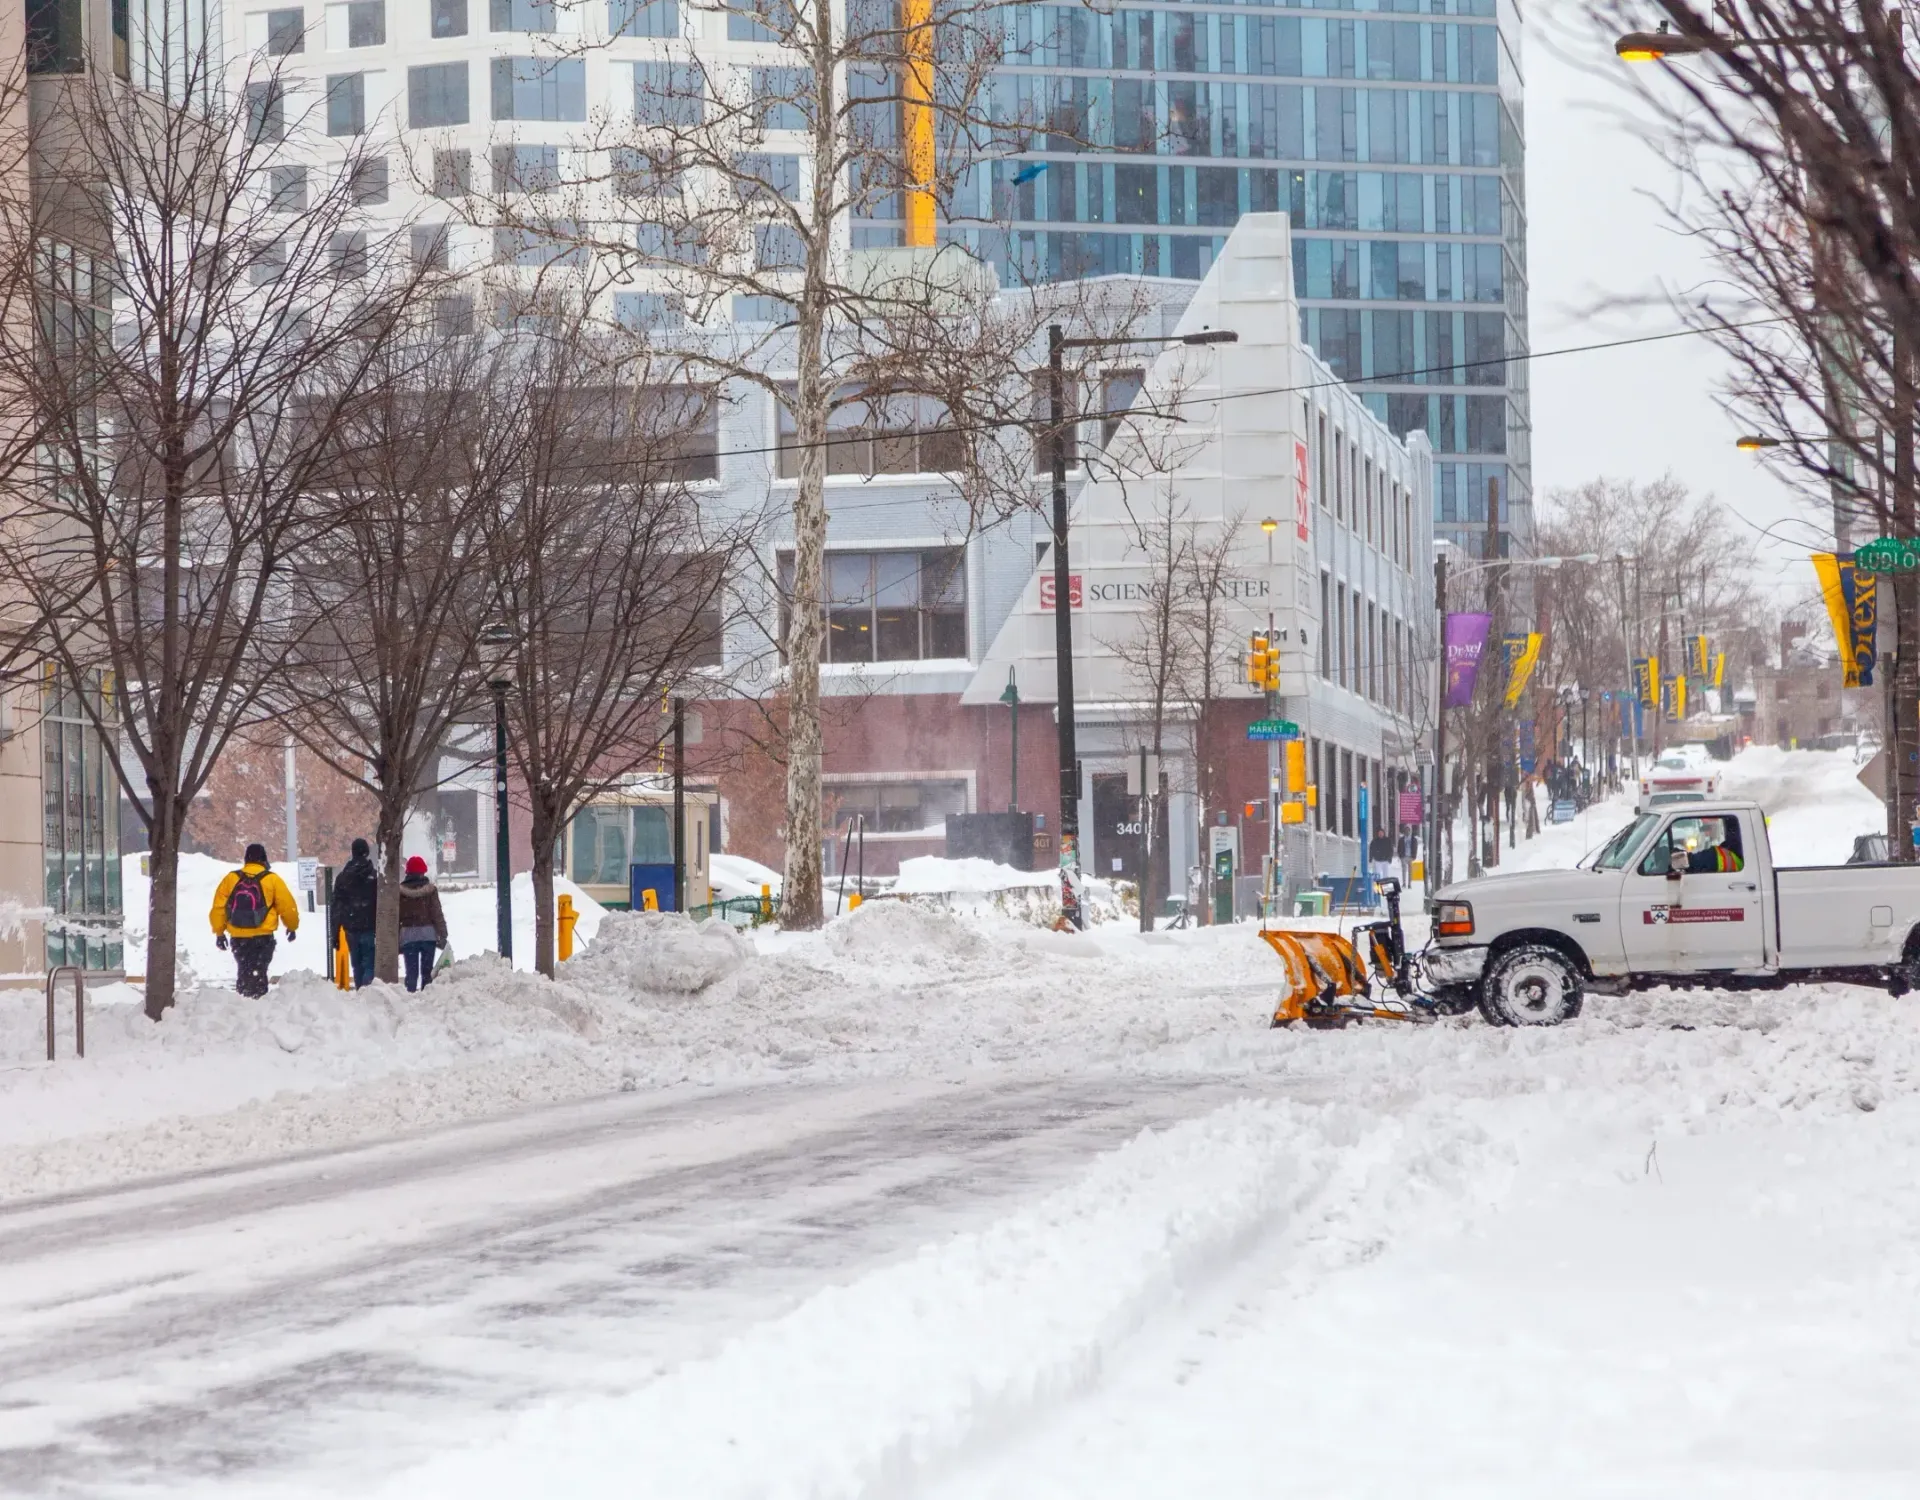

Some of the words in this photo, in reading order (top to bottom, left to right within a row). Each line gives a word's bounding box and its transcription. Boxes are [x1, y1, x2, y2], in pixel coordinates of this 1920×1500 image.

[1860, 551, 1920, 570] LUDLO
[1089, 582, 1178, 601] SCIENCE
[1185, 579, 1270, 599] CENTER
[1249, 725, 1283, 733] MARKET
